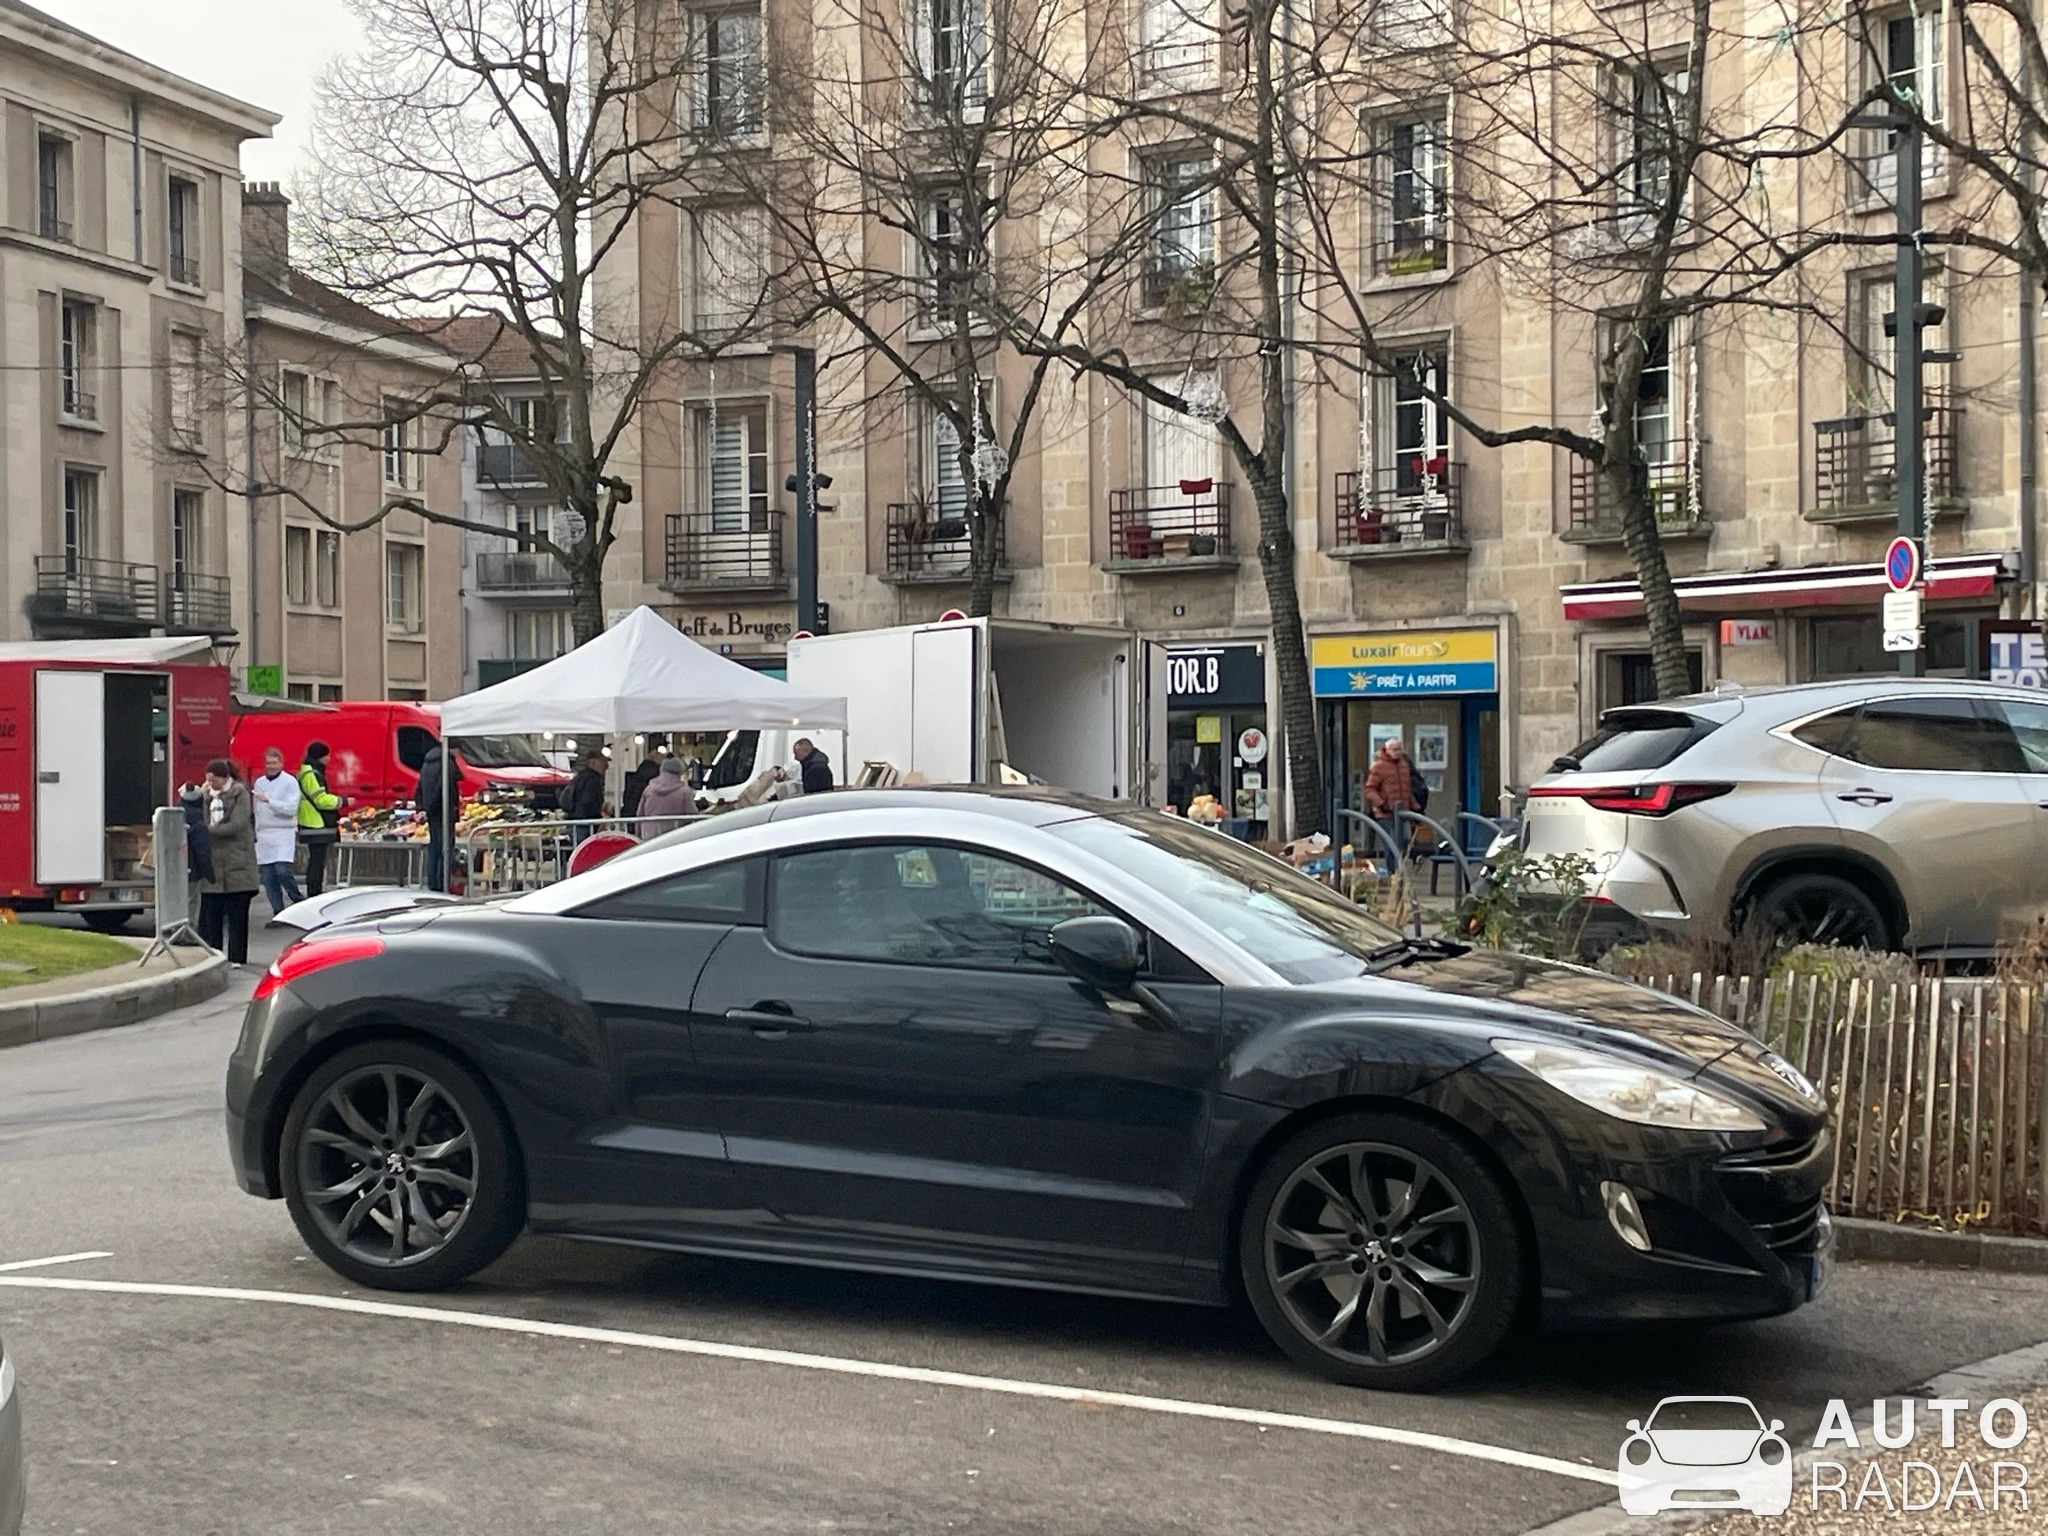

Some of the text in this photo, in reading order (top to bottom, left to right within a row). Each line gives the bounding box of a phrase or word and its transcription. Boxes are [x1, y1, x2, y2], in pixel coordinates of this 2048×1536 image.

[676, 616, 708, 637] Jeff
[709, 622, 724, 636] de
[727, 612, 792, 641] Bruges
[1351, 642, 1433, 659] LuxairTours
[1377, 672, 1457, 688] PRÊT À PARTIR
